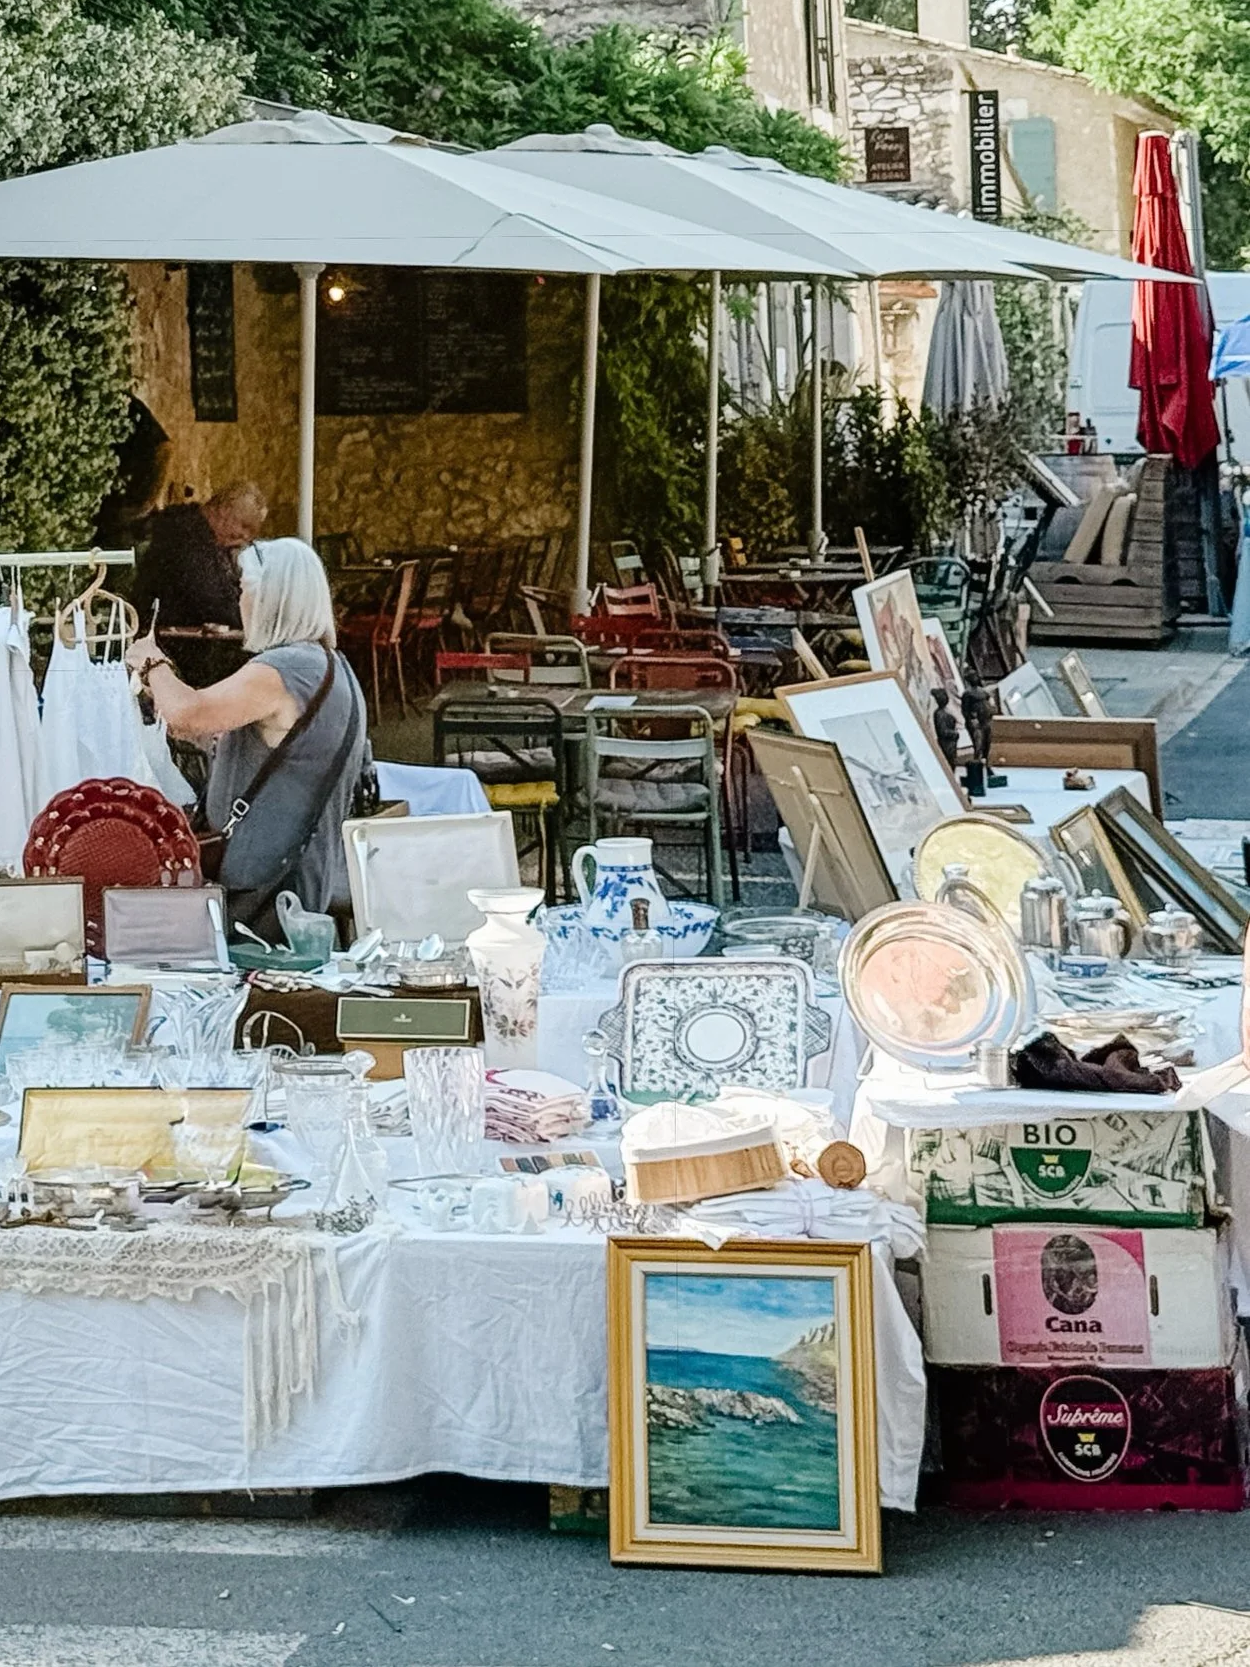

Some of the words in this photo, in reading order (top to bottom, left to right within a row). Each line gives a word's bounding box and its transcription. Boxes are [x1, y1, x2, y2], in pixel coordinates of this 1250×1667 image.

[1023, 1123, 1077, 1146] BIO
[1038, 1164, 1066, 1179] SCB
[1045, 1316, 1103, 1333] Cana
[1047, 1403, 1125, 1427] Suprême
[1074, 1443, 1103, 1457] SCB
